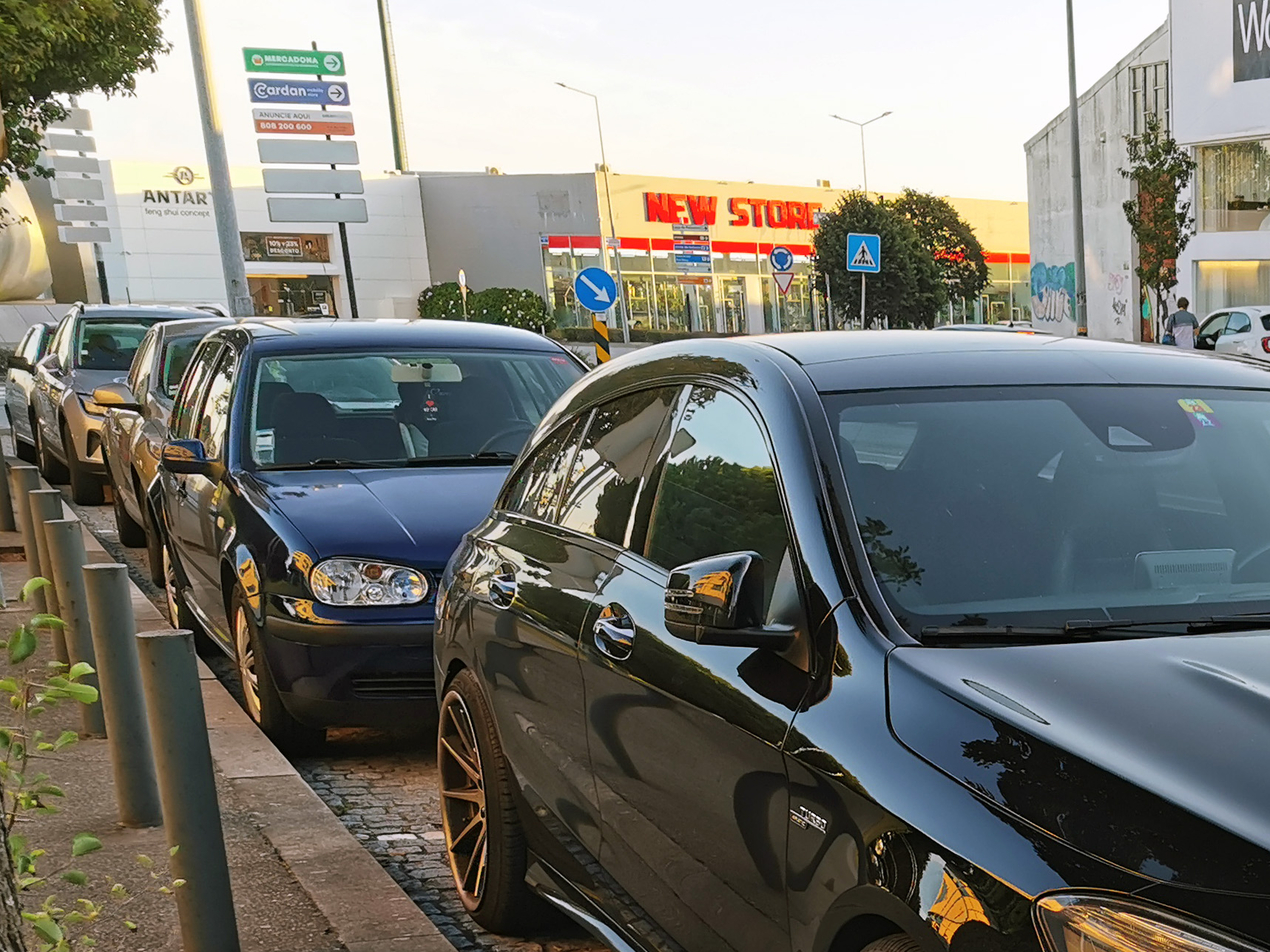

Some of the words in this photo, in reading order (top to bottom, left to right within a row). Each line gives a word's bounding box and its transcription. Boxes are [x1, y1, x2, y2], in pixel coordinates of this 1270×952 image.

[264, 54, 319, 65] MERCADONA
[254, 82, 307, 99] Cardan
[259, 111, 291, 119] ANUNCIE
[260, 122, 277, 130] 808
[278, 122, 294, 130] 200
[295, 123, 312, 131] 600
[142, 189, 213, 205] ANTAR
[145, 208, 163, 217] feng
[164, 208, 179, 216] shui
[180, 210, 211, 218] concept
[643, 191, 718, 226] NEW
[727, 197, 823, 230] STORE
[800, 805, 827, 830] TURBO
